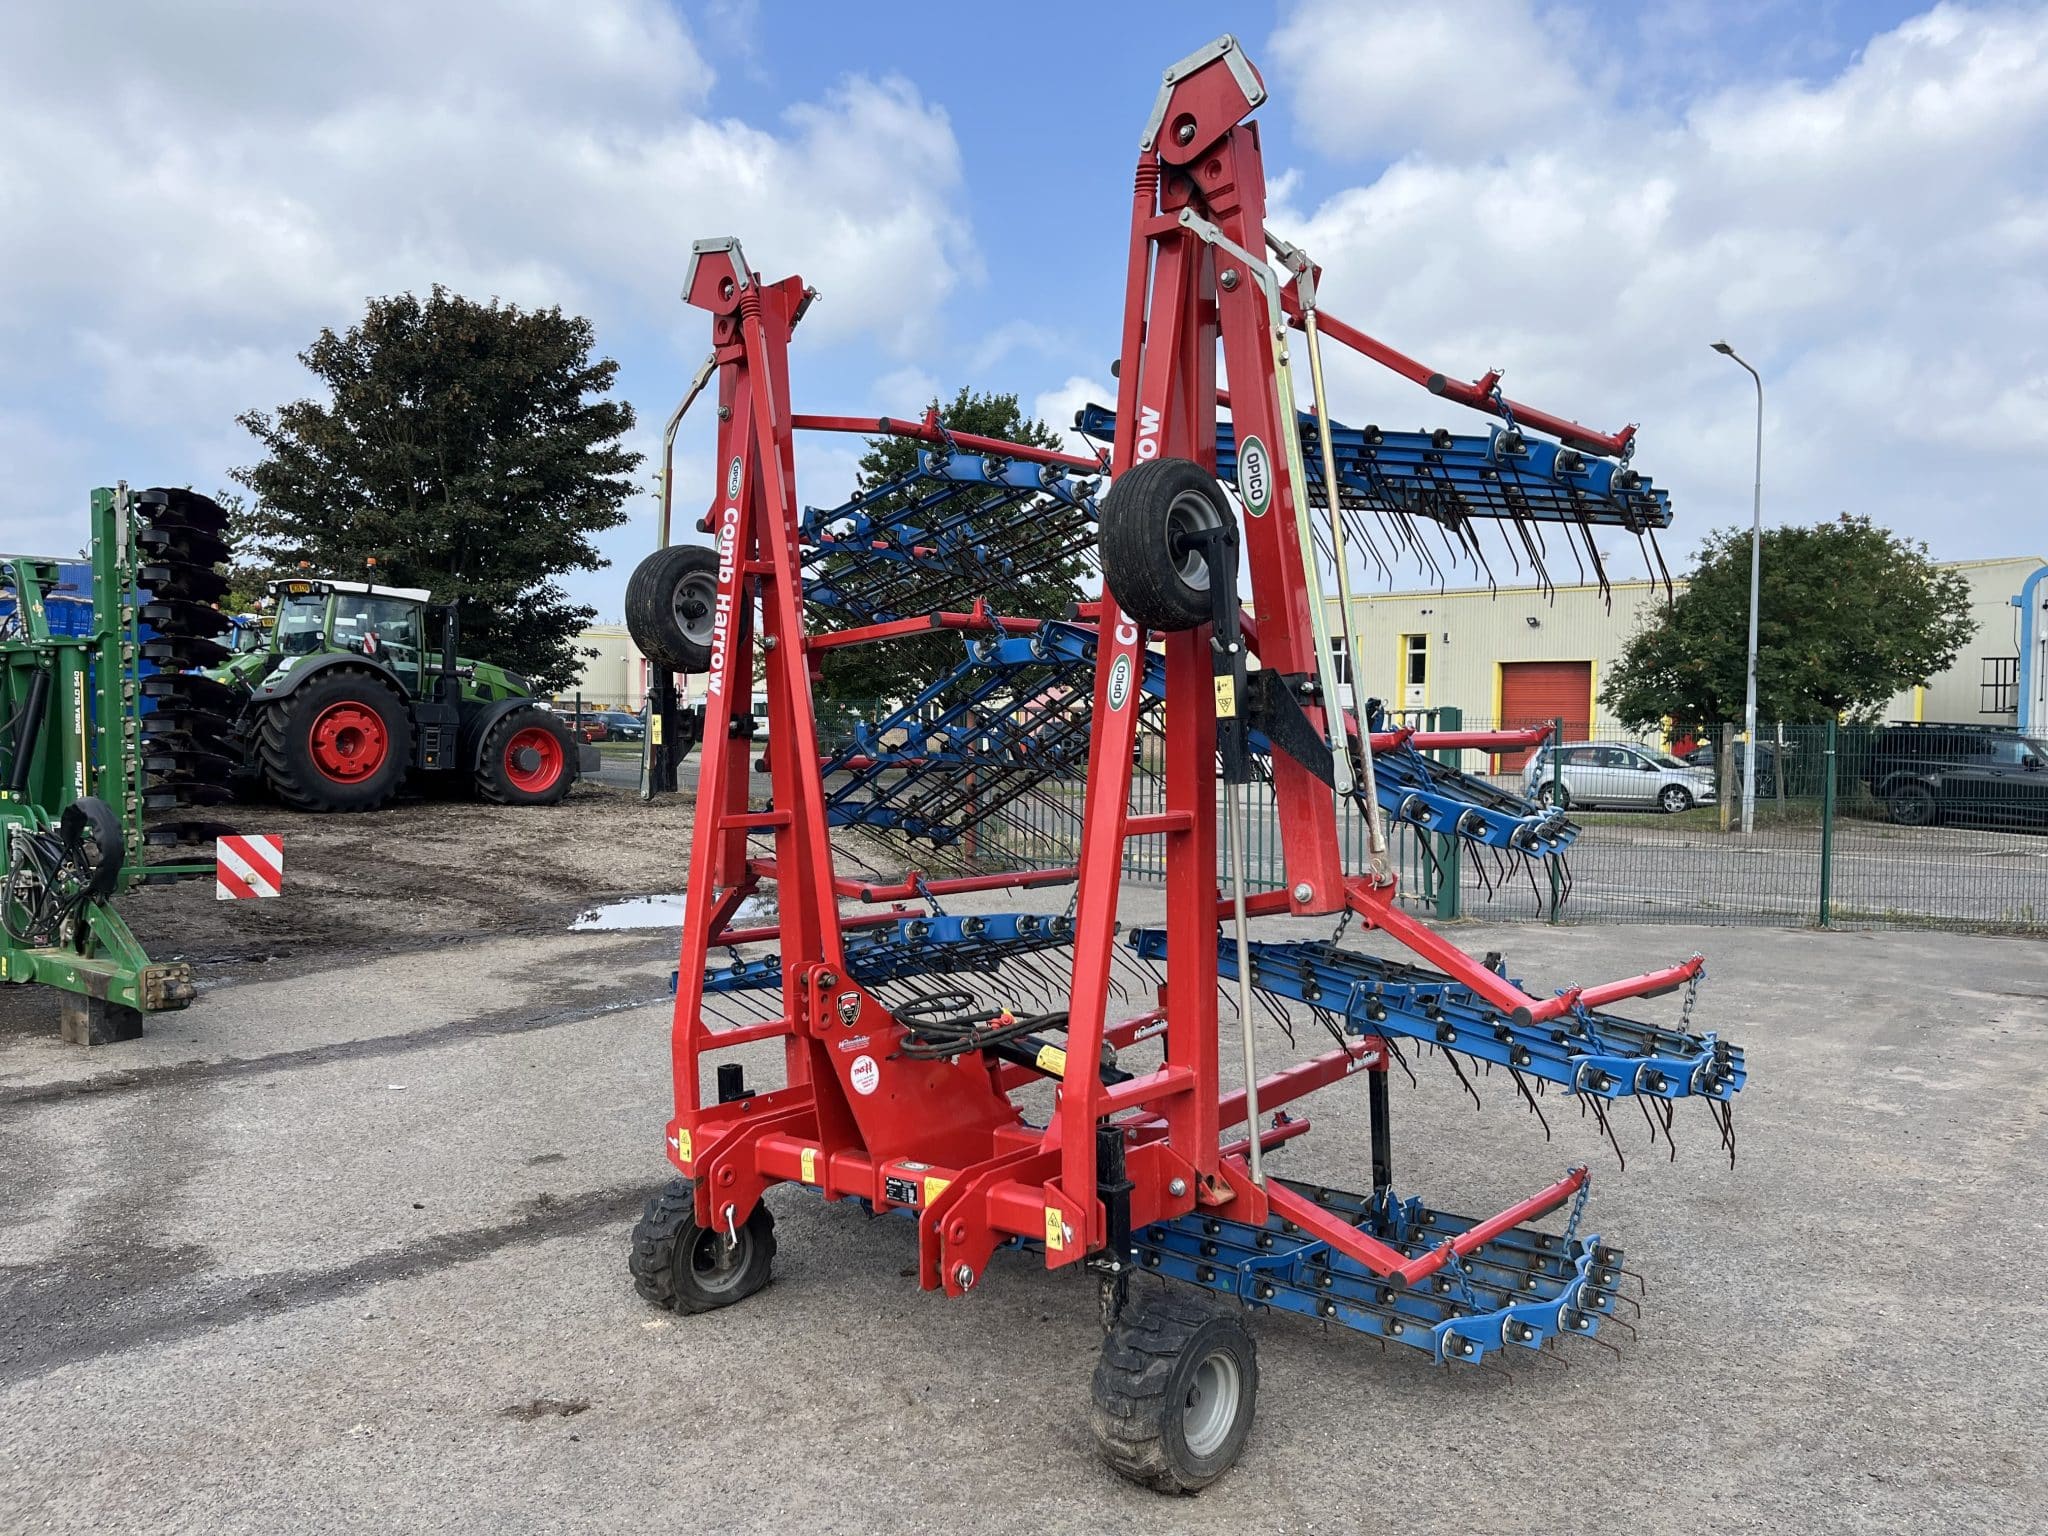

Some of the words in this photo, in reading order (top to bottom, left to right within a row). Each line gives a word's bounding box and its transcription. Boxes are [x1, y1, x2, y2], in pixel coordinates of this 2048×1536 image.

[731, 465, 739, 491] OPICO
[1247, 452, 1263, 501] OPICO
[718, 507, 739, 584] Comb
[709, 593, 731, 697] Harrow
[1113, 665, 1125, 699] OPICO
